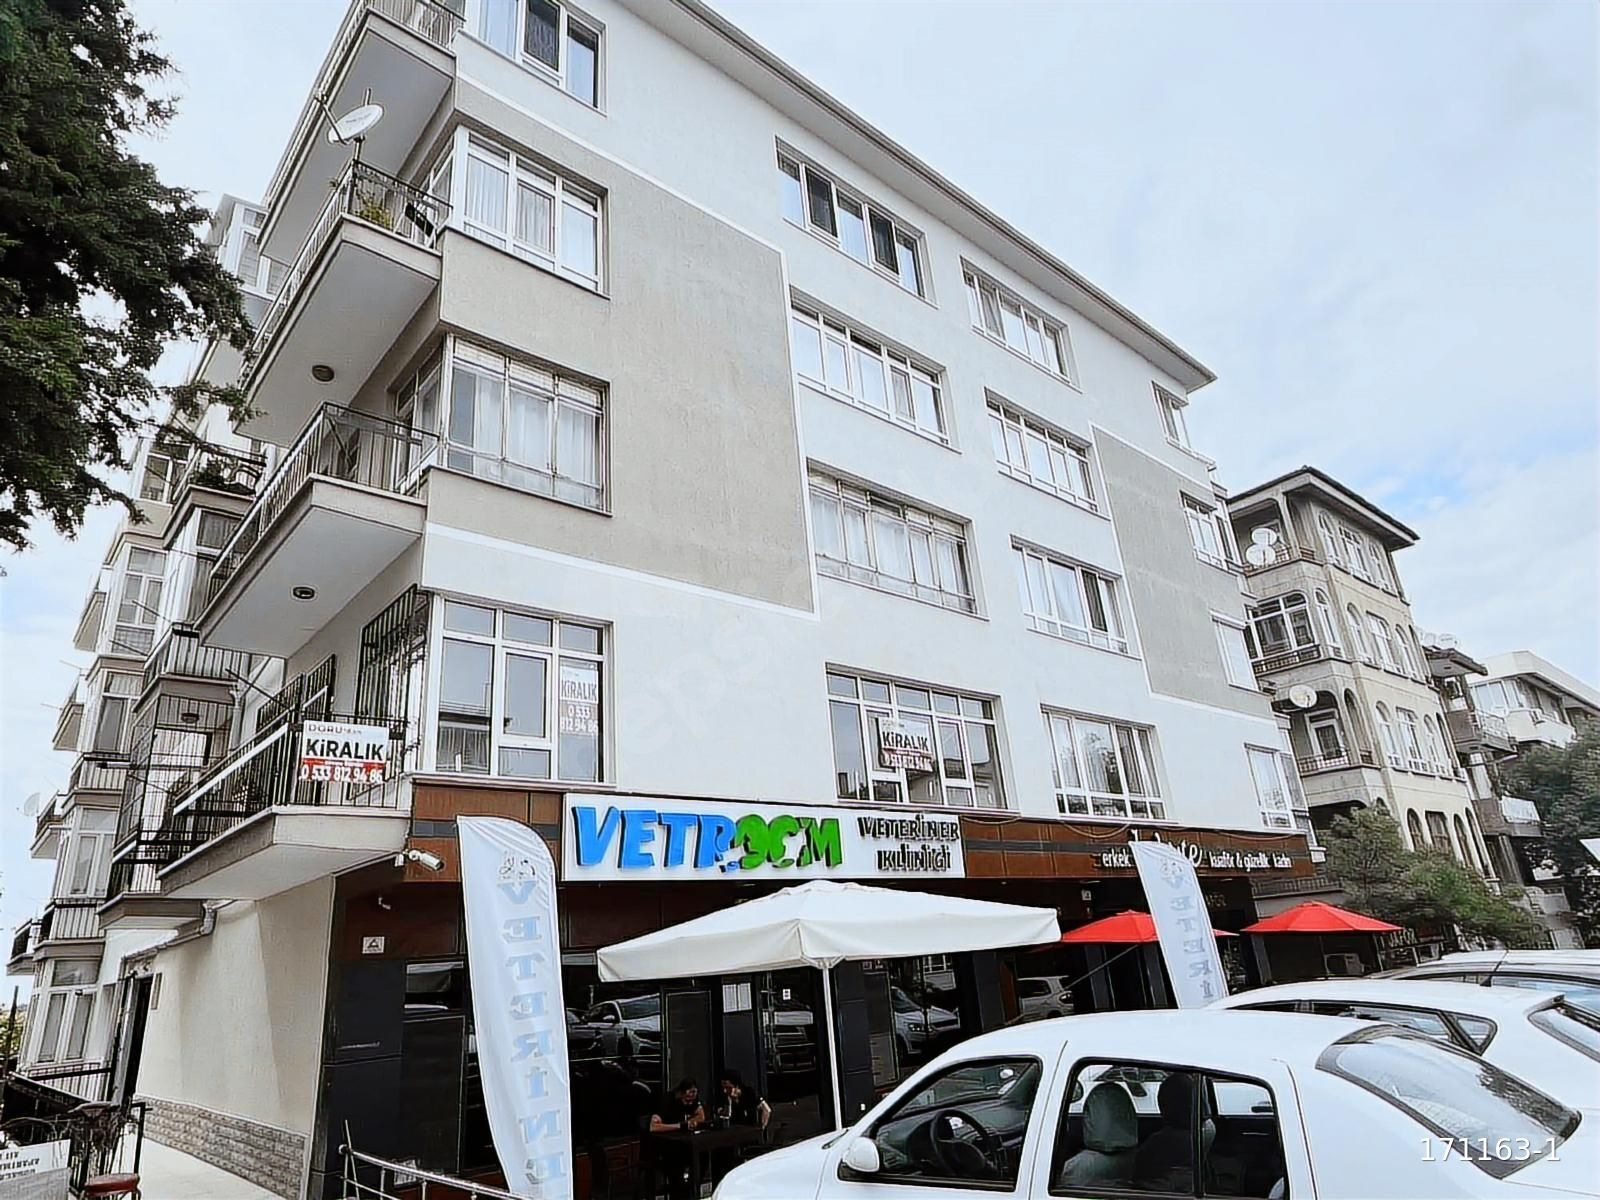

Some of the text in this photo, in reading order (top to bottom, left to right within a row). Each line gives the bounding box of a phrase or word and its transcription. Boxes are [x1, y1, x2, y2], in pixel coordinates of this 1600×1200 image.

[306, 738, 384, 760] KiRALIK
[882, 731, 929, 752] KiRALIK
[301, 764, 310, 778] 0
[312, 765, 331, 781] 533
[334, 766, 351, 782] 812
[857, 814, 959, 841] VETERİNER
[1102, 848, 1132, 868] erkek
